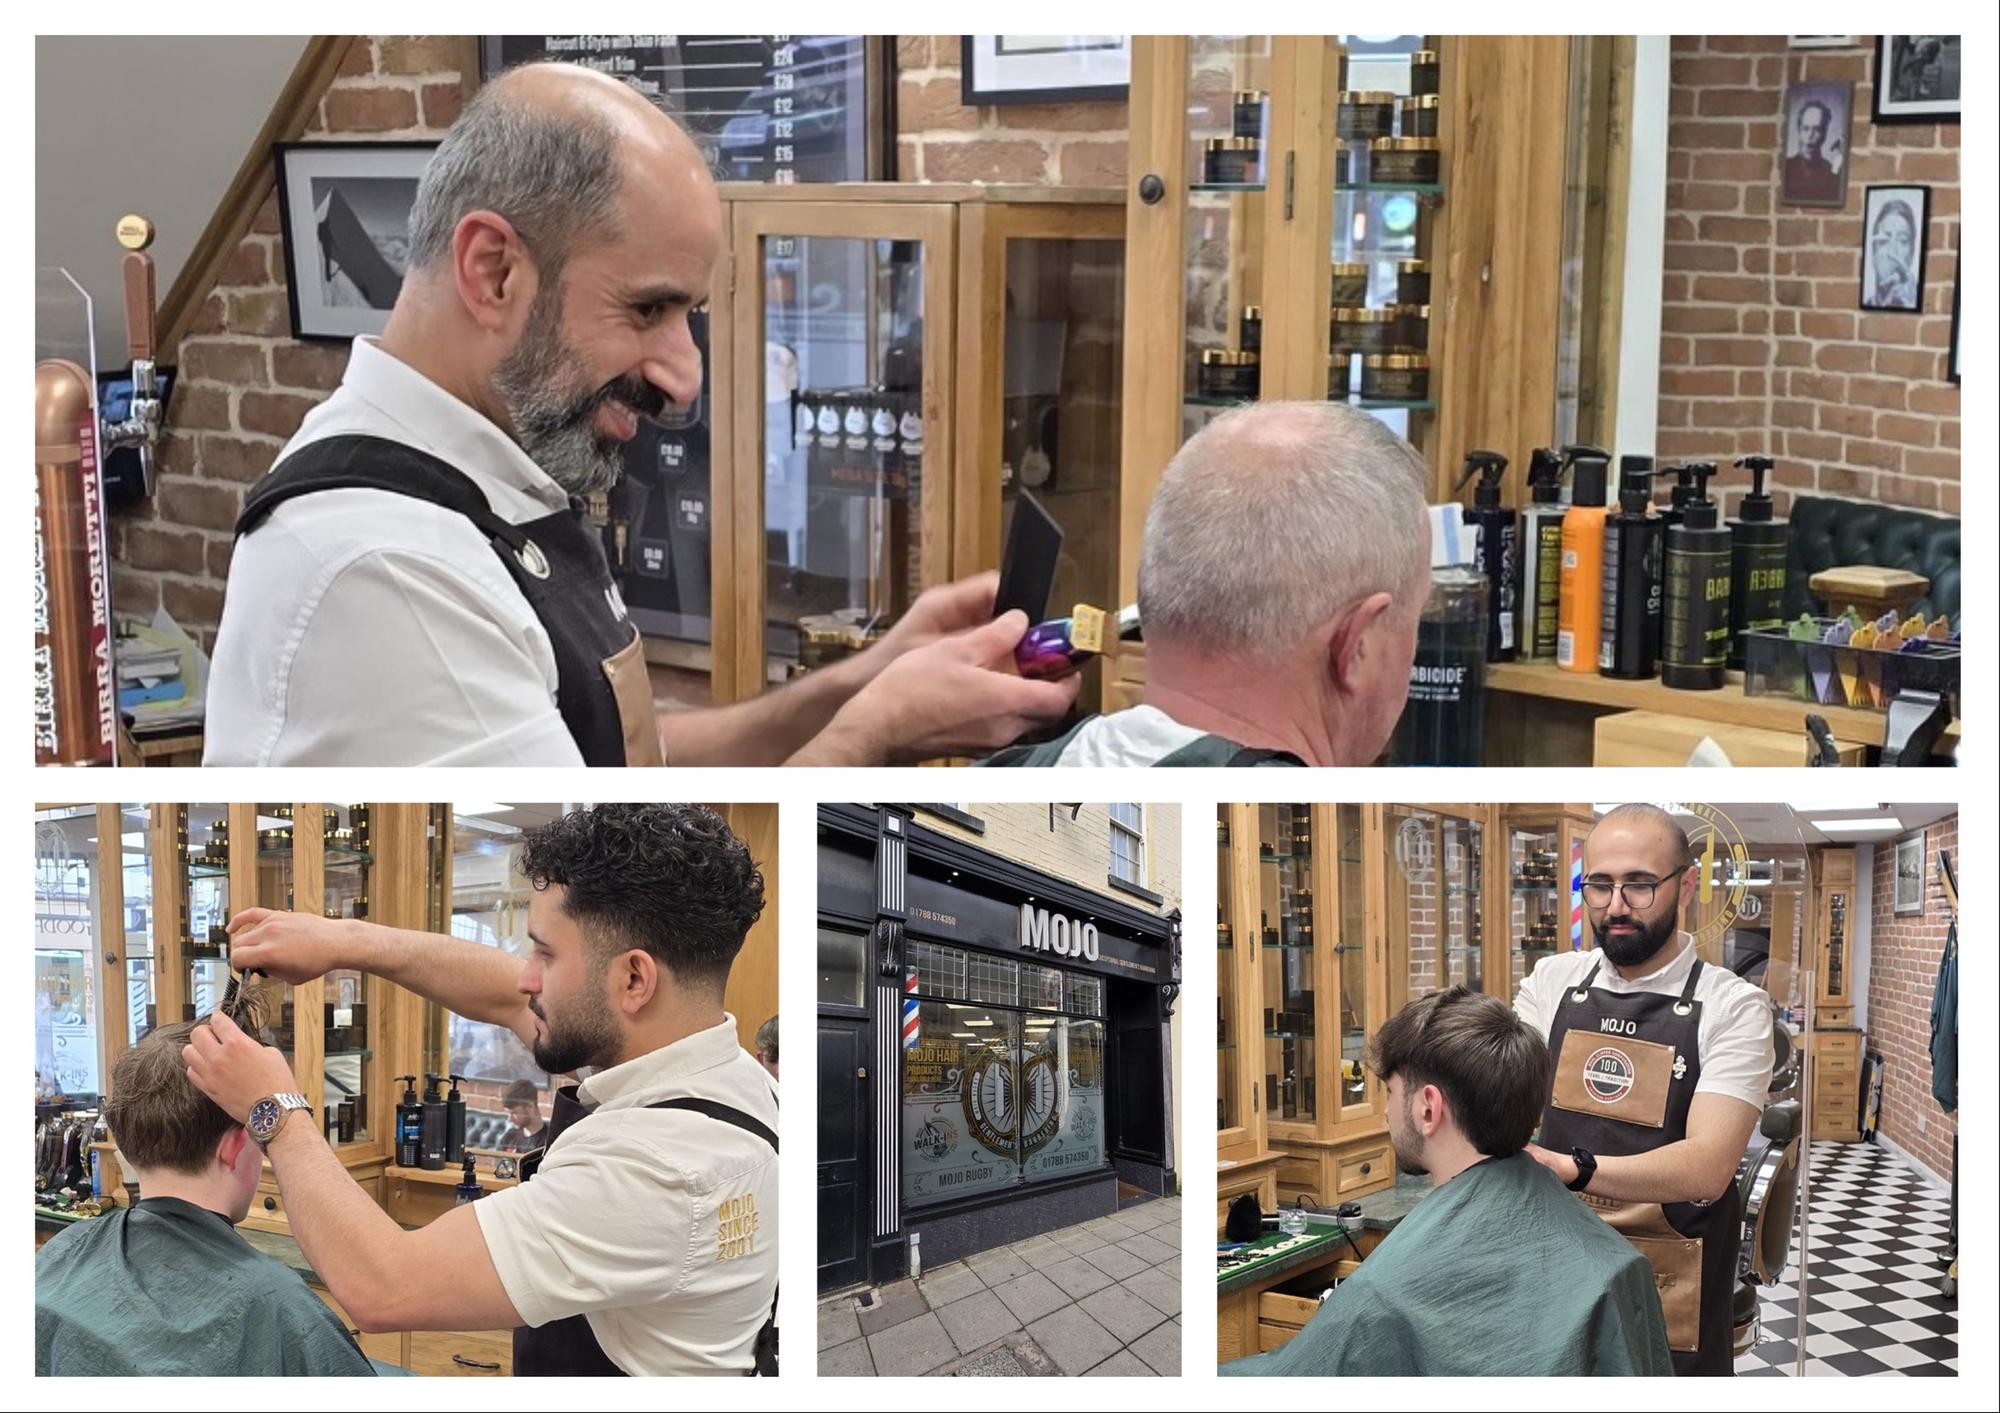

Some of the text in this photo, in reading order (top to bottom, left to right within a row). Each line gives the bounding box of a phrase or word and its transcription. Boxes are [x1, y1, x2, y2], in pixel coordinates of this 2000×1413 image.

[82, 473, 113, 746] BIRRA MORETTI
[1410, 666, 1463, 683] RBICIDE
[1021, 903, 1099, 962] MOJO
[1600, 1017, 1637, 1035] MOJO
[907, 1047, 960, 1063] MOJO HAIR
[1600, 1059, 1618, 1074] 100
[60, 1067, 89, 1082] K-INS
[939, 1165, 994, 1188] MOJO RUGBY
[719, 1193, 755, 1222] MOJO
[719, 1211, 760, 1242] SINCE
[716, 1232, 754, 1261] 2001
